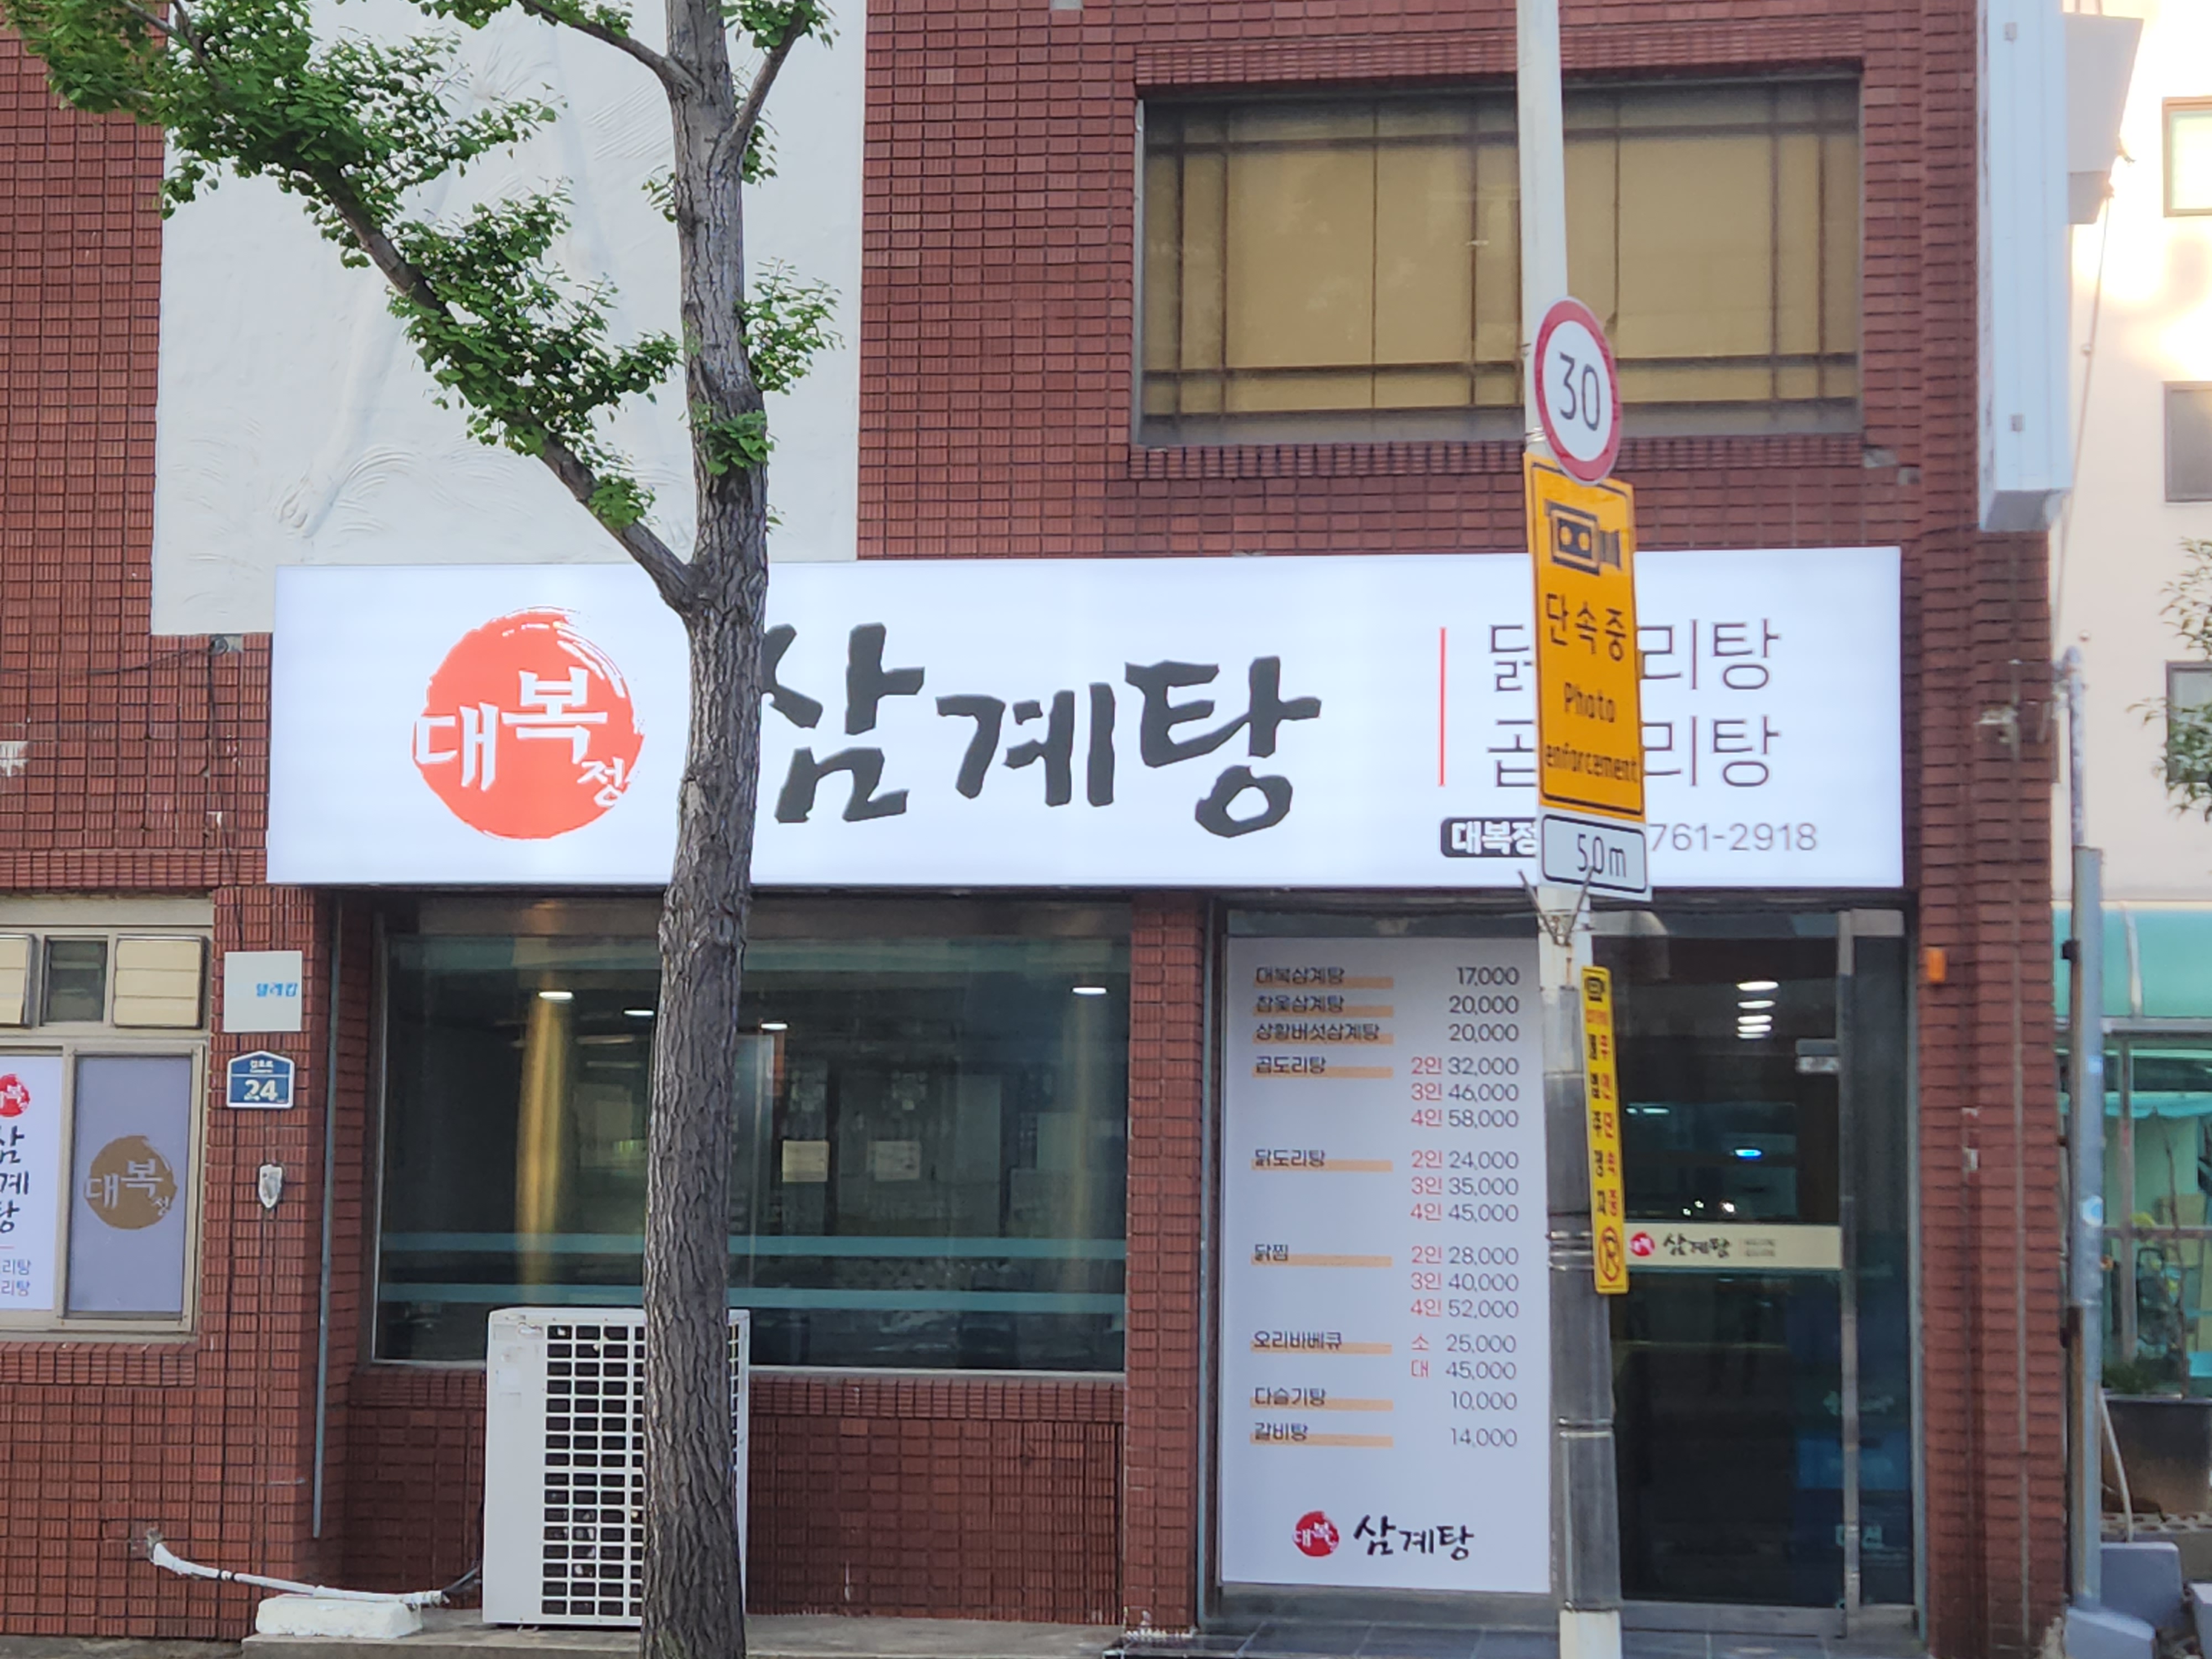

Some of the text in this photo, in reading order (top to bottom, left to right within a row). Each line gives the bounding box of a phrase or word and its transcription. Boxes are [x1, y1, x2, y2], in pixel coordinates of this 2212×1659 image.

[1558, 351, 1600, 431] 30
[1546, 592, 1627, 662] 단속중
[1488, 618, 1782, 692] 닭리탕
[1564, 682, 1616, 724] Photo
[415, 666, 627, 808] 대복정
[761, 622, 1322, 838] 삼계탕
[1486, 716, 1782, 787] 곰리탕
[1546, 743, 1639, 785] enforcement
[1650, 822, 1818, 852] 761-2918
[1577, 834, 1627, 878] 50m
[1256, 967, 1520, 987] 대복삼계탕 17,000
[1448, 995, 1519, 1015] 20,000
[1255, 1023, 1519, 1044] 상황버섯삼계탕 20,000
[1411, 1057, 1442, 1075] 2인
[1448, 1057, 1519, 1077] 32,000
[244, 1079, 278, 1102] 24
[1411, 1083, 1519, 1103] 3인 46,000
[1411, 1109, 1519, 1130] 4인 58,000
[1255, 1150, 1519, 1171] 닭도리탕 2인 24,000
[1411, 1177, 1519, 1197] 3인 35,000
[1411, 1203, 1519, 1223] 4인 45,000
[1255, 1244, 1519, 1266] 닭찜 2인 28,000
[1411, 1273, 1519, 1293] 3인 40,000
[1411, 1299, 1519, 1319] 4인 52,000
[1411, 1334, 1430, 1351] 소
[1446, 1334, 1516, 1354] 25,000
[1411, 1360, 1516, 1380] 대 45,000
[1255, 1387, 1517, 1411] 다슬기탕 10,000
[1255, 1423, 1517, 1448] 갈비탕 14,000
[1354, 1515, 1474, 1561] 삼계탕
